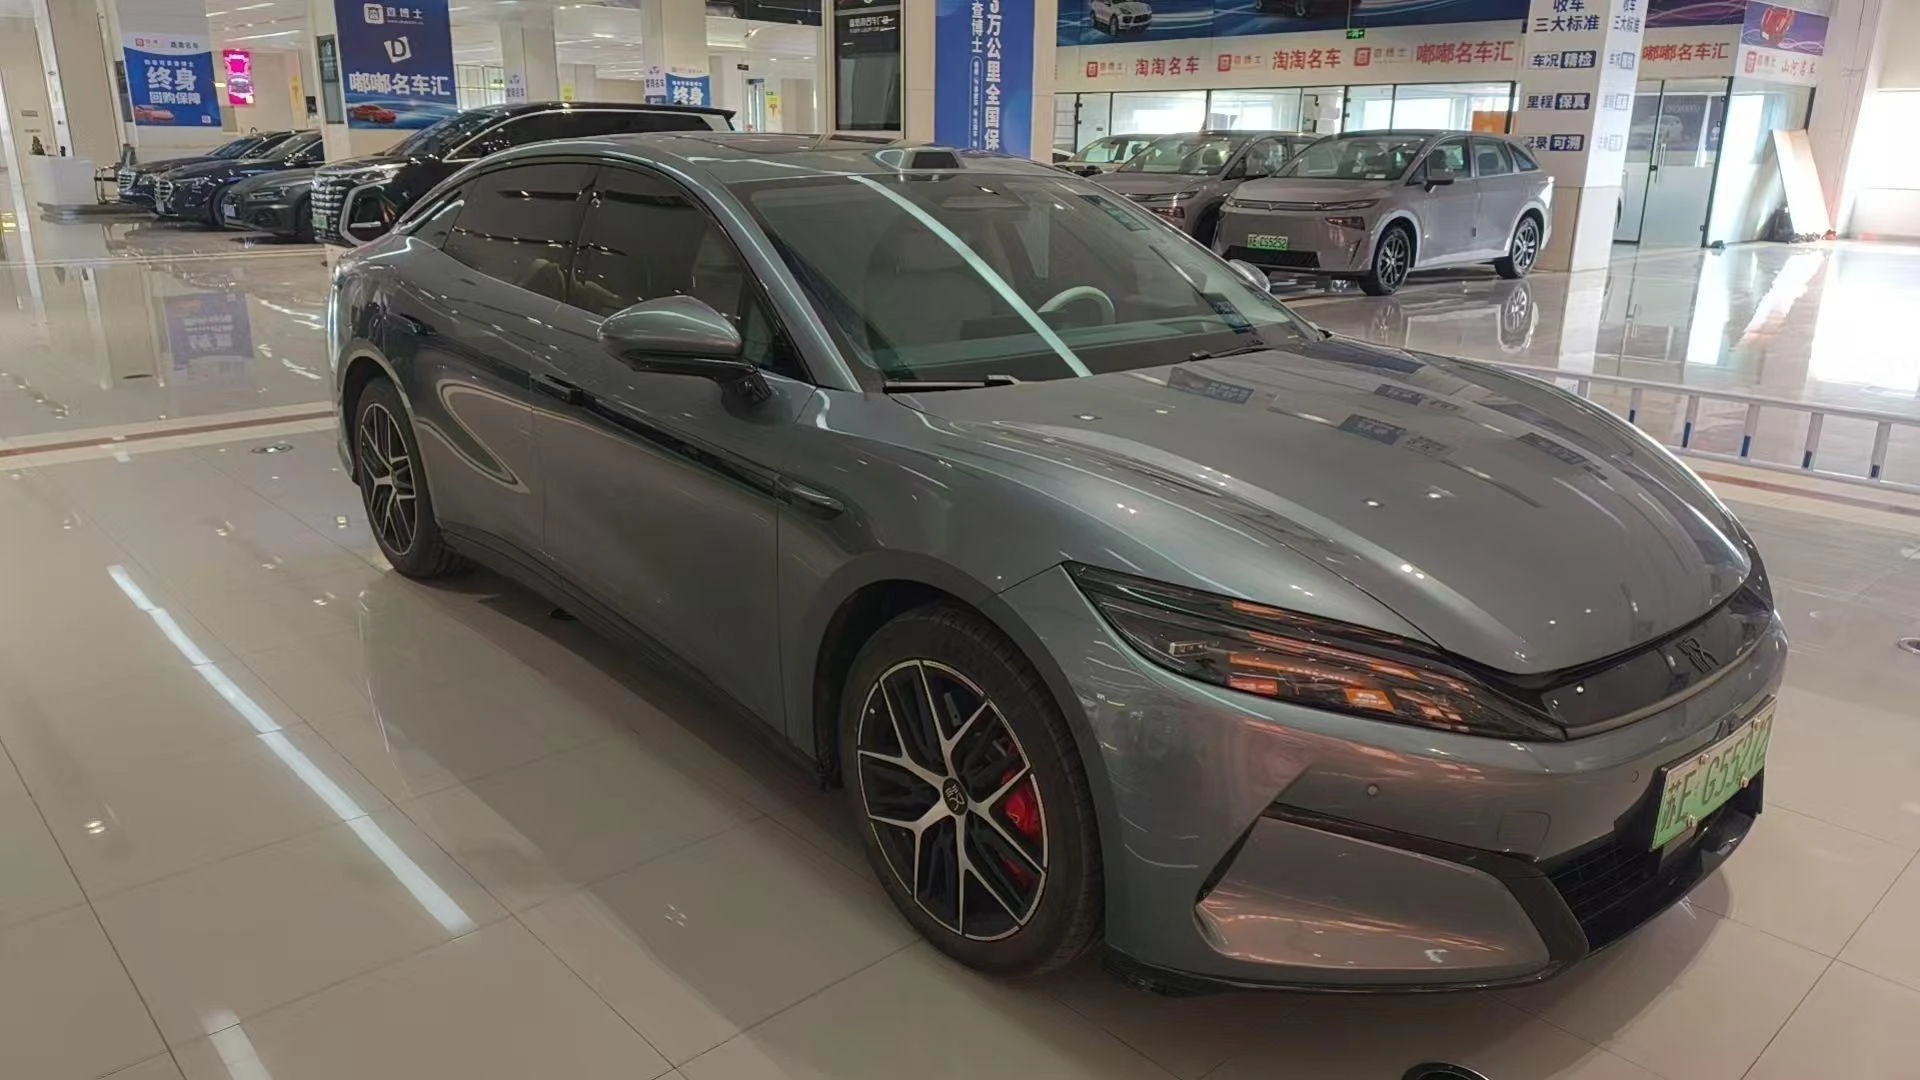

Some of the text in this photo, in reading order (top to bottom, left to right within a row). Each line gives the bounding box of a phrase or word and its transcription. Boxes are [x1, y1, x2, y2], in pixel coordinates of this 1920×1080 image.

[972, 0, 984, 53] 查博士
[1533, 14, 1600, 32] 三大标准
[1272, 48, 1341, 70] 淘淘名车
[1416, 40, 1515, 64] 嘟嘟名车汇
[1533, 52, 1593, 68] 车况精检
[1642, 42, 1730, 62] 嘟嘟名车汇
[1136, 56, 1200, 77] 淘淘名车
[146, 66, 197, 91] 终身
[349, 72, 451, 95] 嘟嘟名车汇
[1526, 94, 1588, 109] 里程保真
